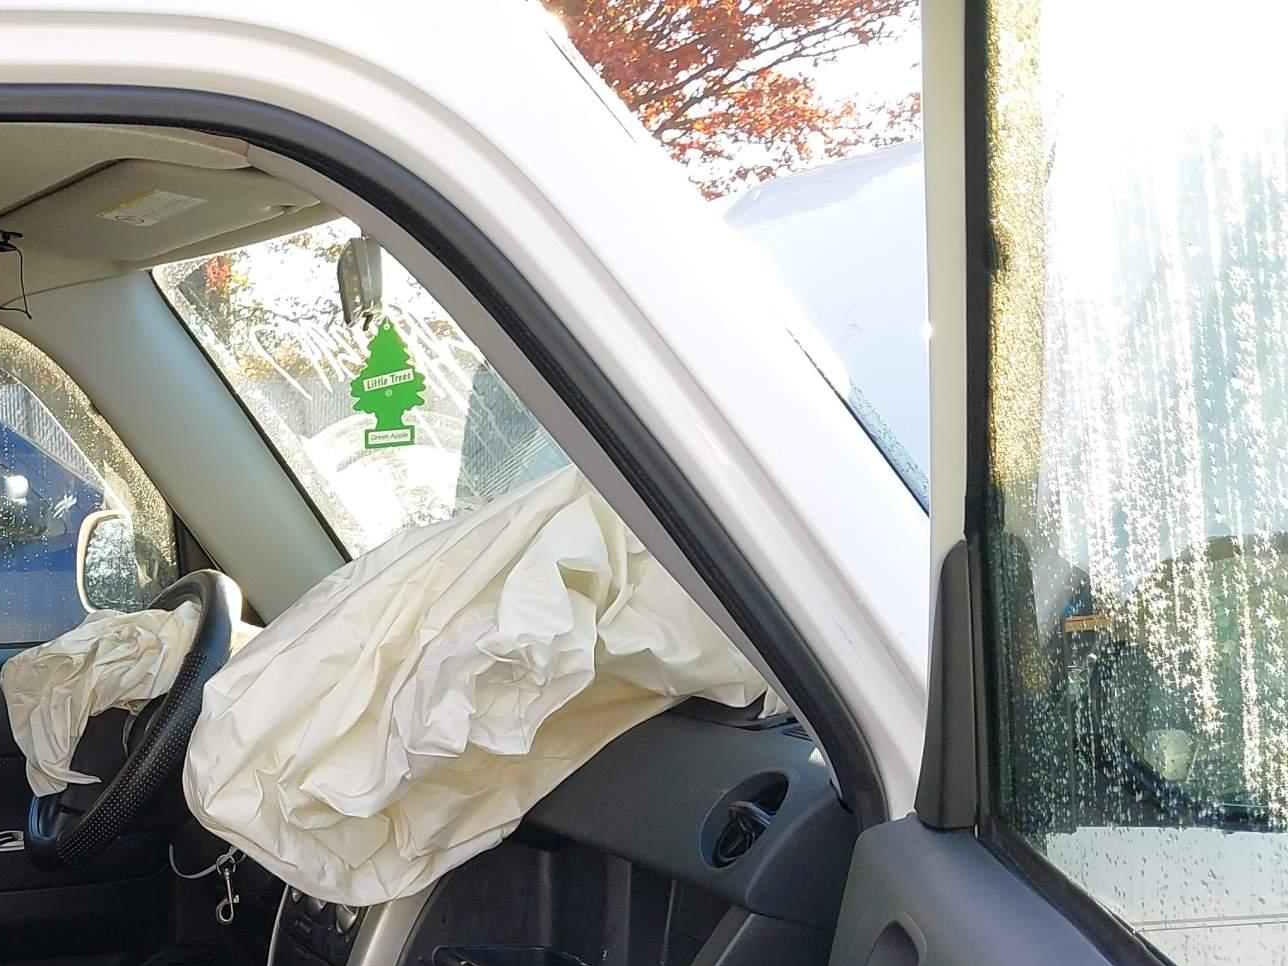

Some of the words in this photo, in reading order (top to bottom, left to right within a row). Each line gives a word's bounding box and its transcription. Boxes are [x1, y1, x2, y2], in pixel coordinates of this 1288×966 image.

[366, 377, 389, 390] Little
[391, 373, 411, 384] Trees
[370, 433, 390, 441] Green
[391, 431, 409, 440] Apple
